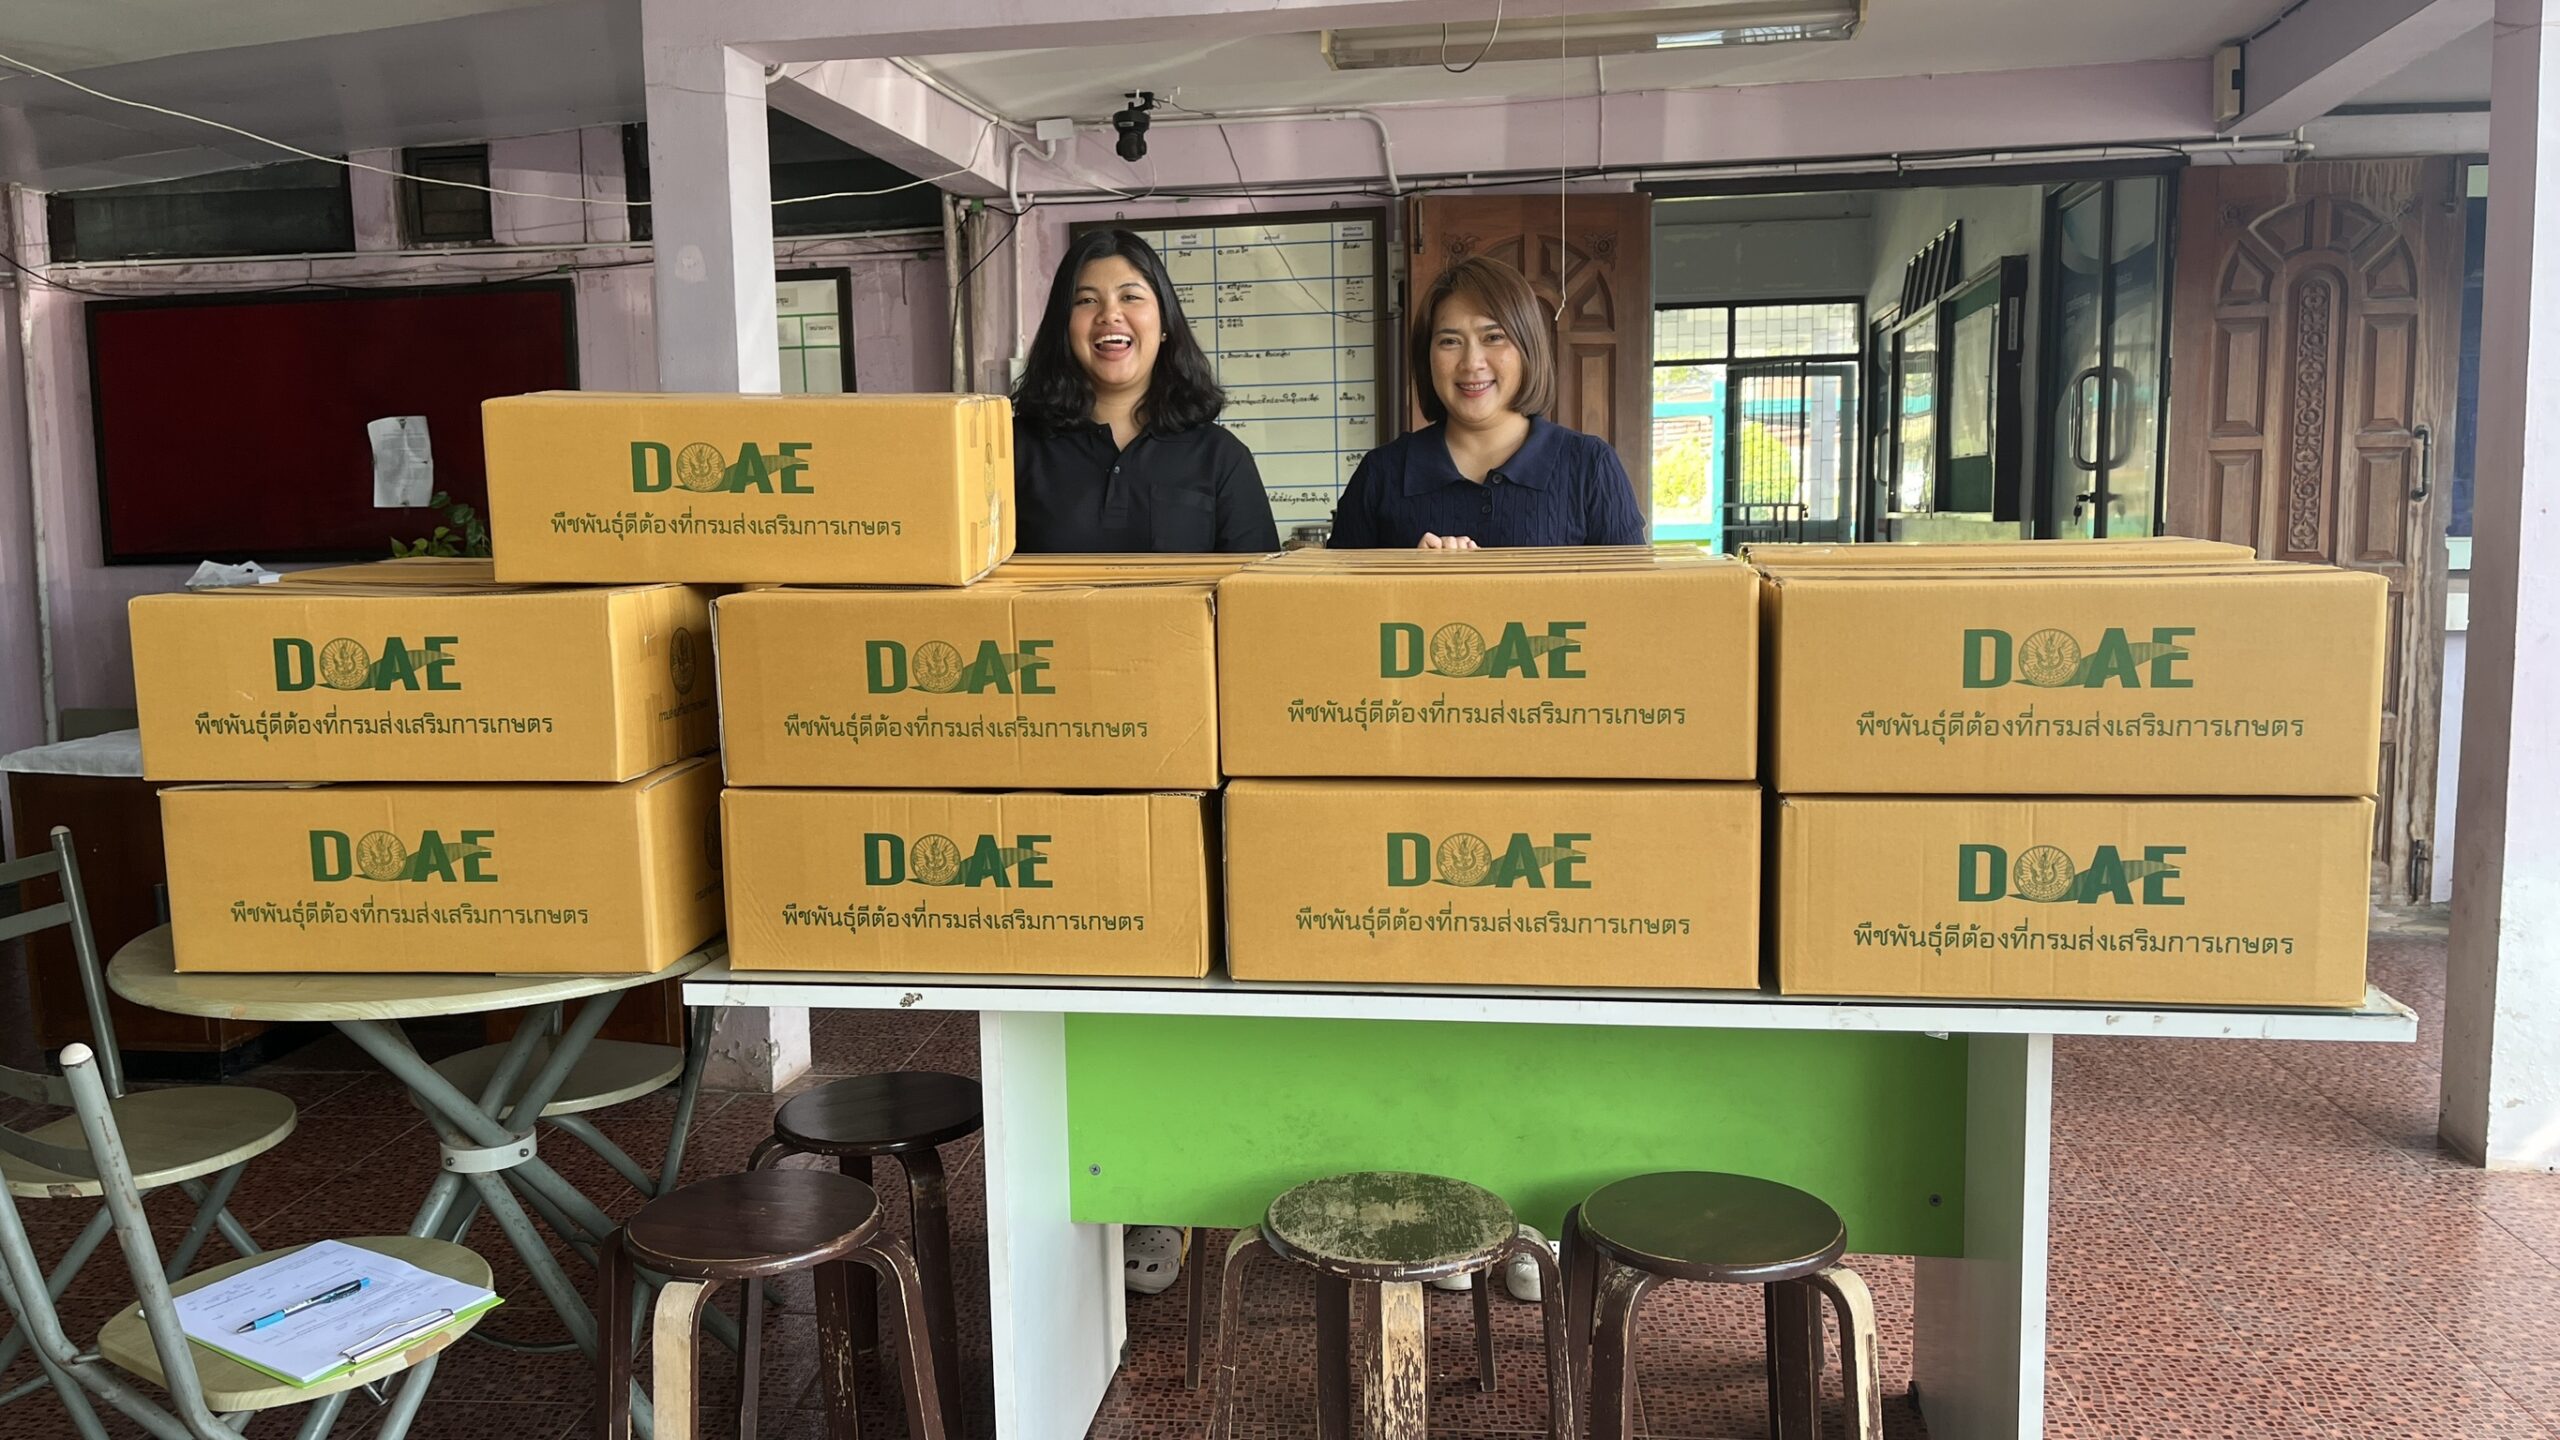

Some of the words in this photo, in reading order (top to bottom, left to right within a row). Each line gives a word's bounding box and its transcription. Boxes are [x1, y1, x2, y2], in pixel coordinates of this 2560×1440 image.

[550, 506, 902, 541] พืชพันธุ์ดีต้องที่กรมส่งเสริมการเกษตร
[195, 705, 554, 742] พืชพันธุ์ดีต้องที่กรมส่งเสริมการเกษตร
[784, 708, 1149, 744] พืชพันธุ์ดีต้องที่กรมส่งเสริมการเกษตร
[1288, 692, 1686, 731] พืชพันธุ์ดีต้องที่กรมส่งเสริมการเกษตร
[1855, 704, 2304, 746] พืชพันธุ์ดีต้องที่กรมส่งเสริมการเกษตร
[231, 895, 589, 931] พืชพันธุ์ดีต้องที่กรมส่งเสริมการเกษตร
[782, 899, 1145, 935] พืชพันธุ์ดีต้องที่กรมส่งเสริมการเกษตร
[1296, 901, 1691, 938] พืชพันธุ์ดีต้องที่กรมส่งเสริมการเกษตร
[1854, 917, 2294, 957] พืชพันธุ์ดีต้องที่กรมส่งเสริมการเกษตร
